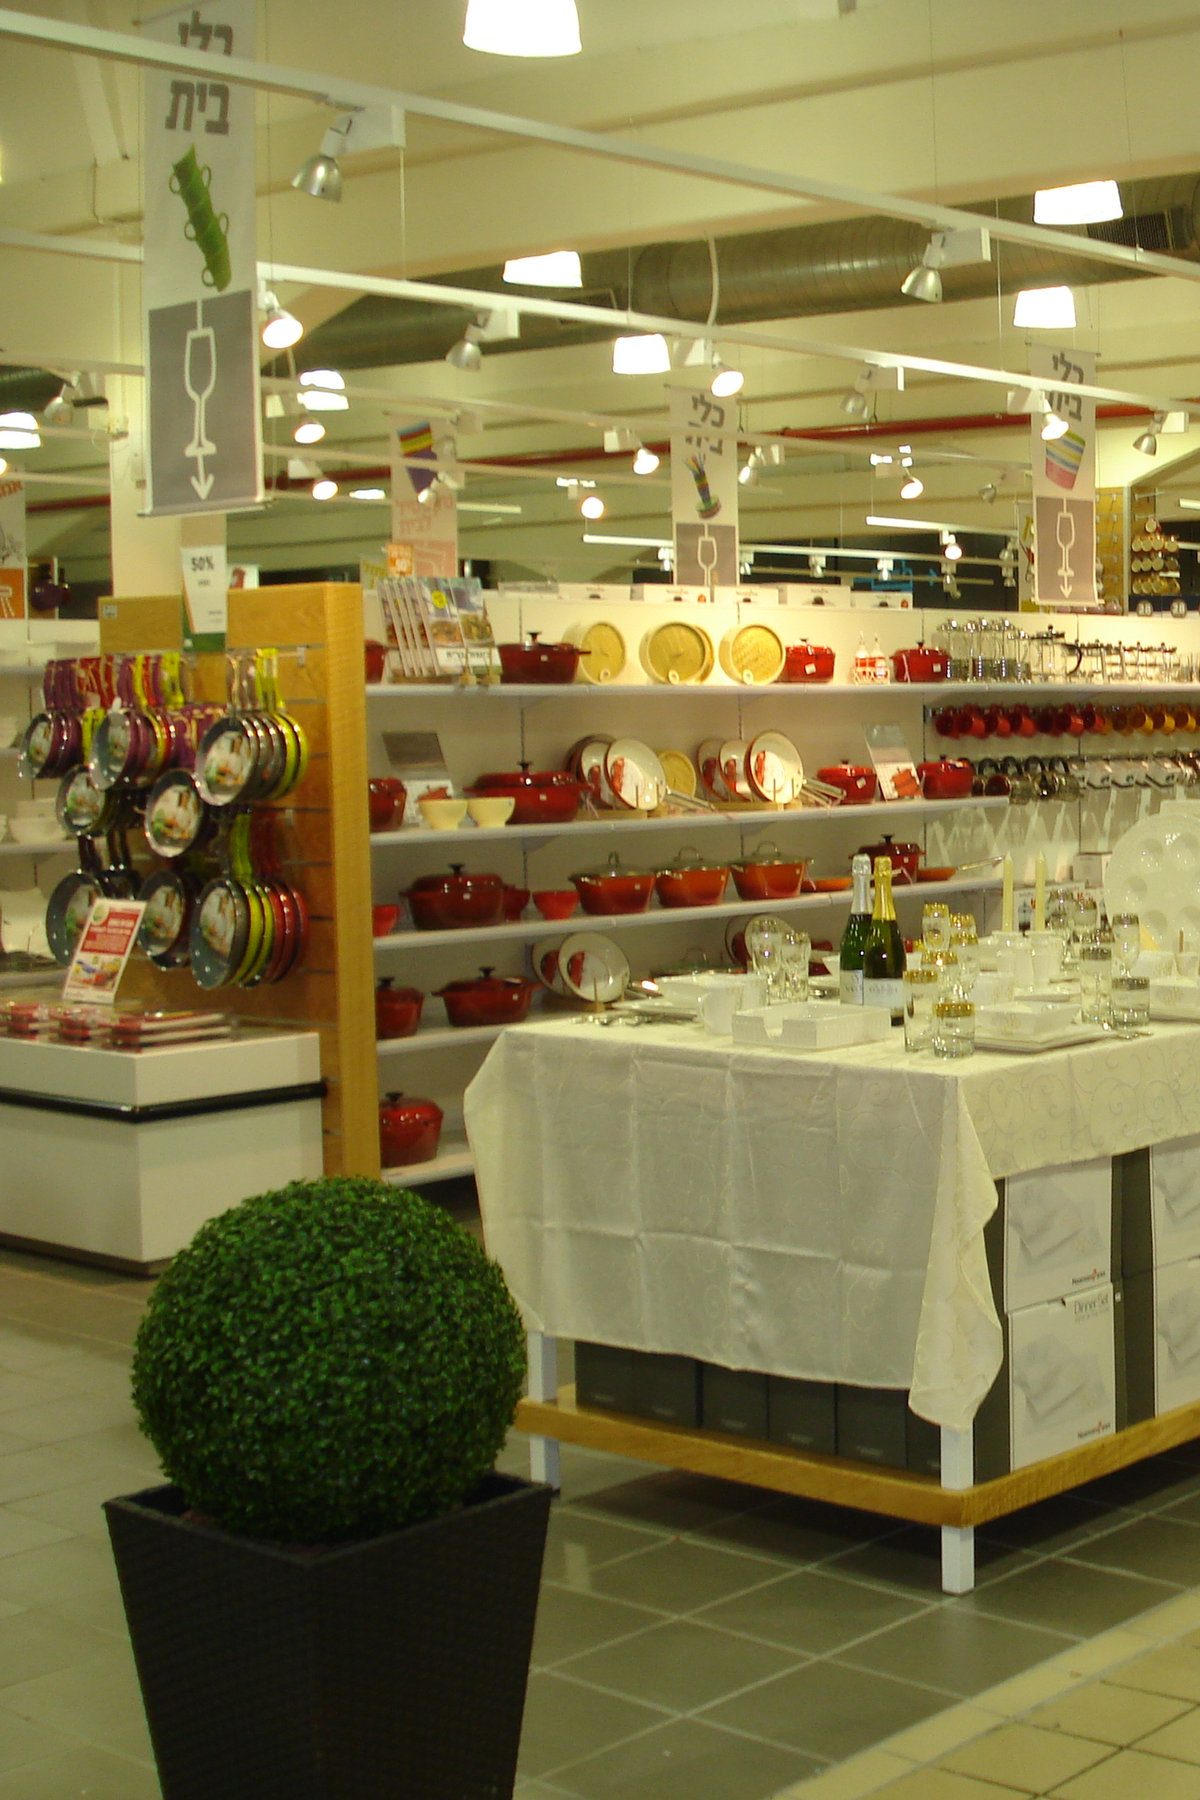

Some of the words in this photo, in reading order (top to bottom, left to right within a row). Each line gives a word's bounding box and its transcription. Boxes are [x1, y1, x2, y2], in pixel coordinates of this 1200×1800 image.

[165, 79, 230, 136] בית
[691, 393, 725, 428] כלי
[191, 555, 215, 572] 50%
